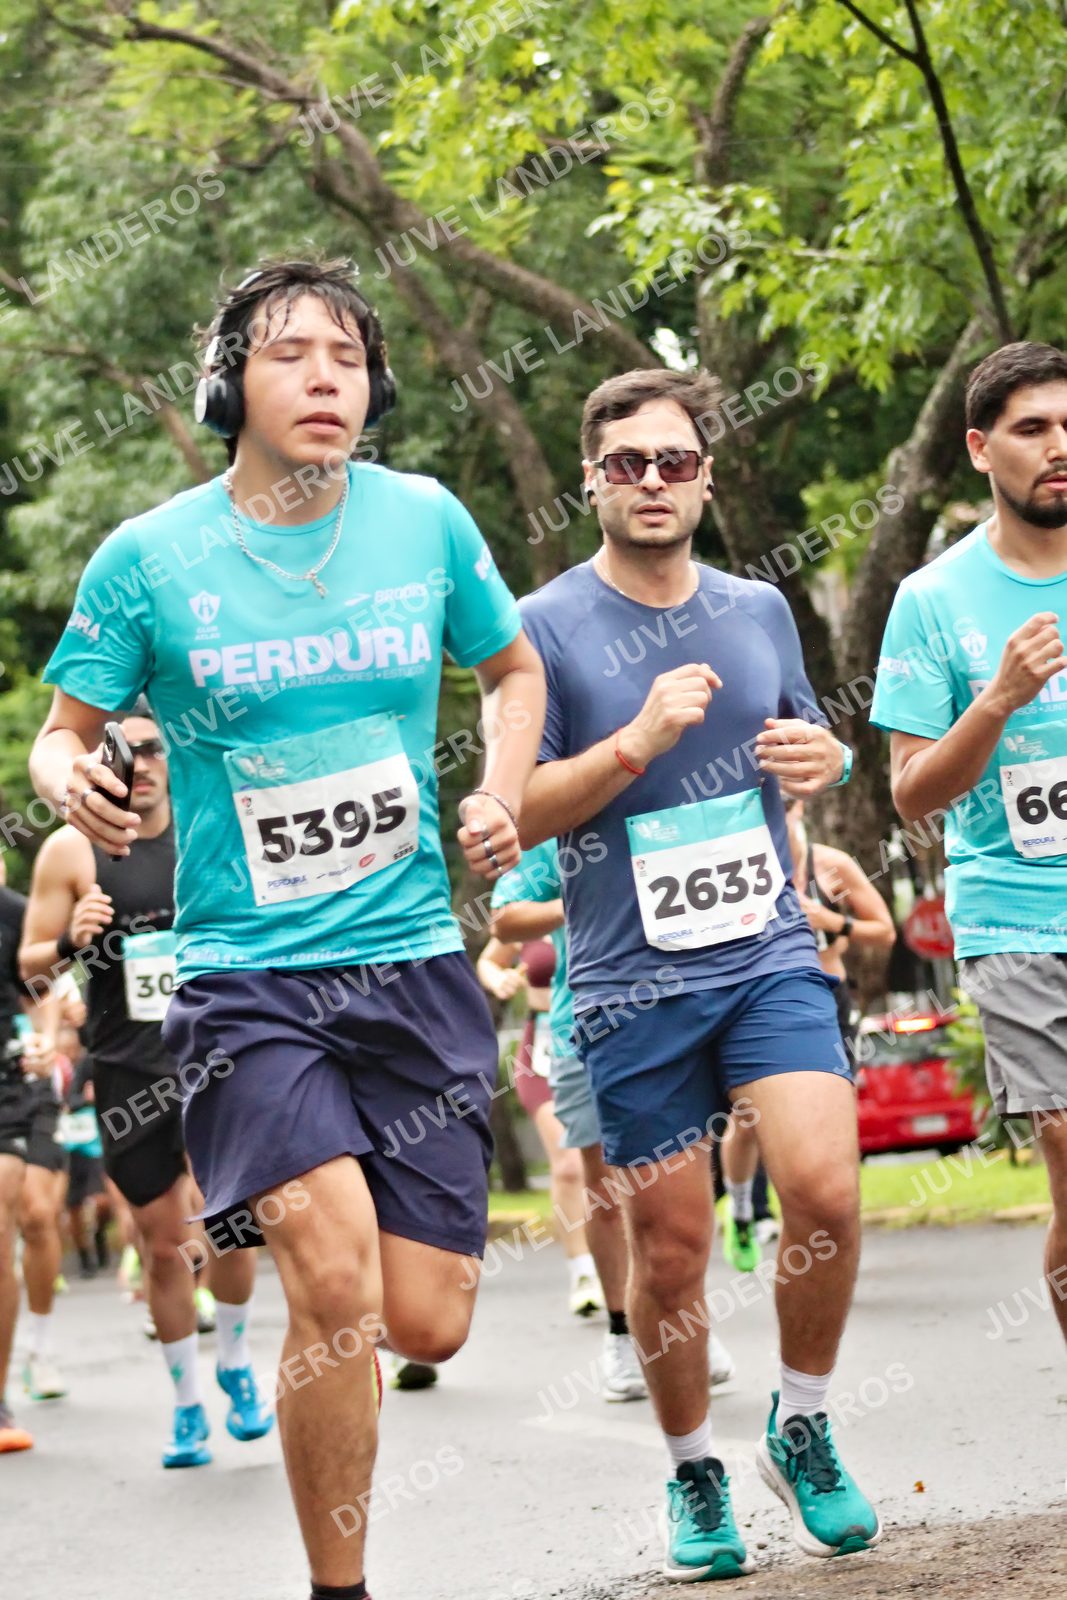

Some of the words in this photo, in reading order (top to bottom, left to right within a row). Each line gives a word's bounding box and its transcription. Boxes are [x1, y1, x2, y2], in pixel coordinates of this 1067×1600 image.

[187, 622, 433, 688] PERDURA
[287, 670, 374, 690] JUNTEADORES
[257, 786, 407, 864] 5395
[648, 852, 773, 921] 2633
